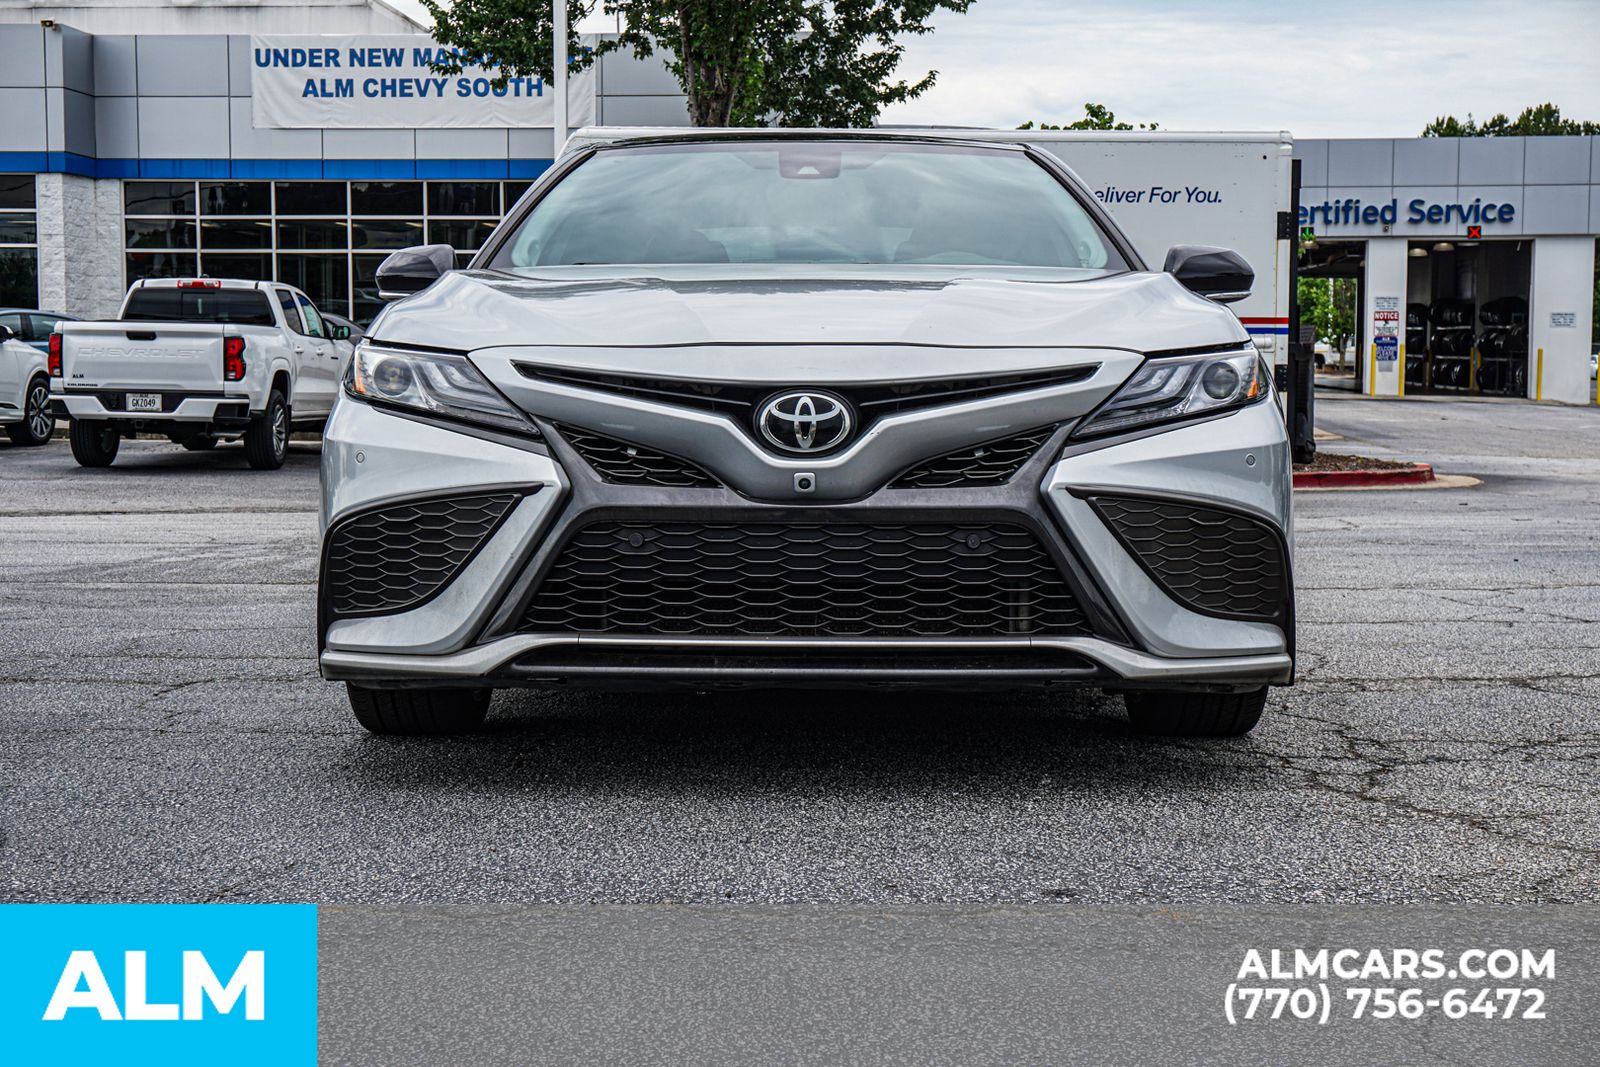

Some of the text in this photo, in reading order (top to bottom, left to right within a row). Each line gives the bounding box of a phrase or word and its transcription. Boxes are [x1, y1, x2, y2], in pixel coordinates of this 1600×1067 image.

[254, 48, 341, 68] UNDER
[349, 48, 405, 67] NEW
[302, 78, 354, 97] ALM
[362, 78, 448, 97] CHEVY
[1094, 186, 1223, 203] eliver For You.
[1299, 198, 1515, 226] ertified Service
[1375, 312, 1398, 320] NOTICE
[79, 347, 204, 359] CHEVROLET
[131, 398, 156, 408] GKZ049
